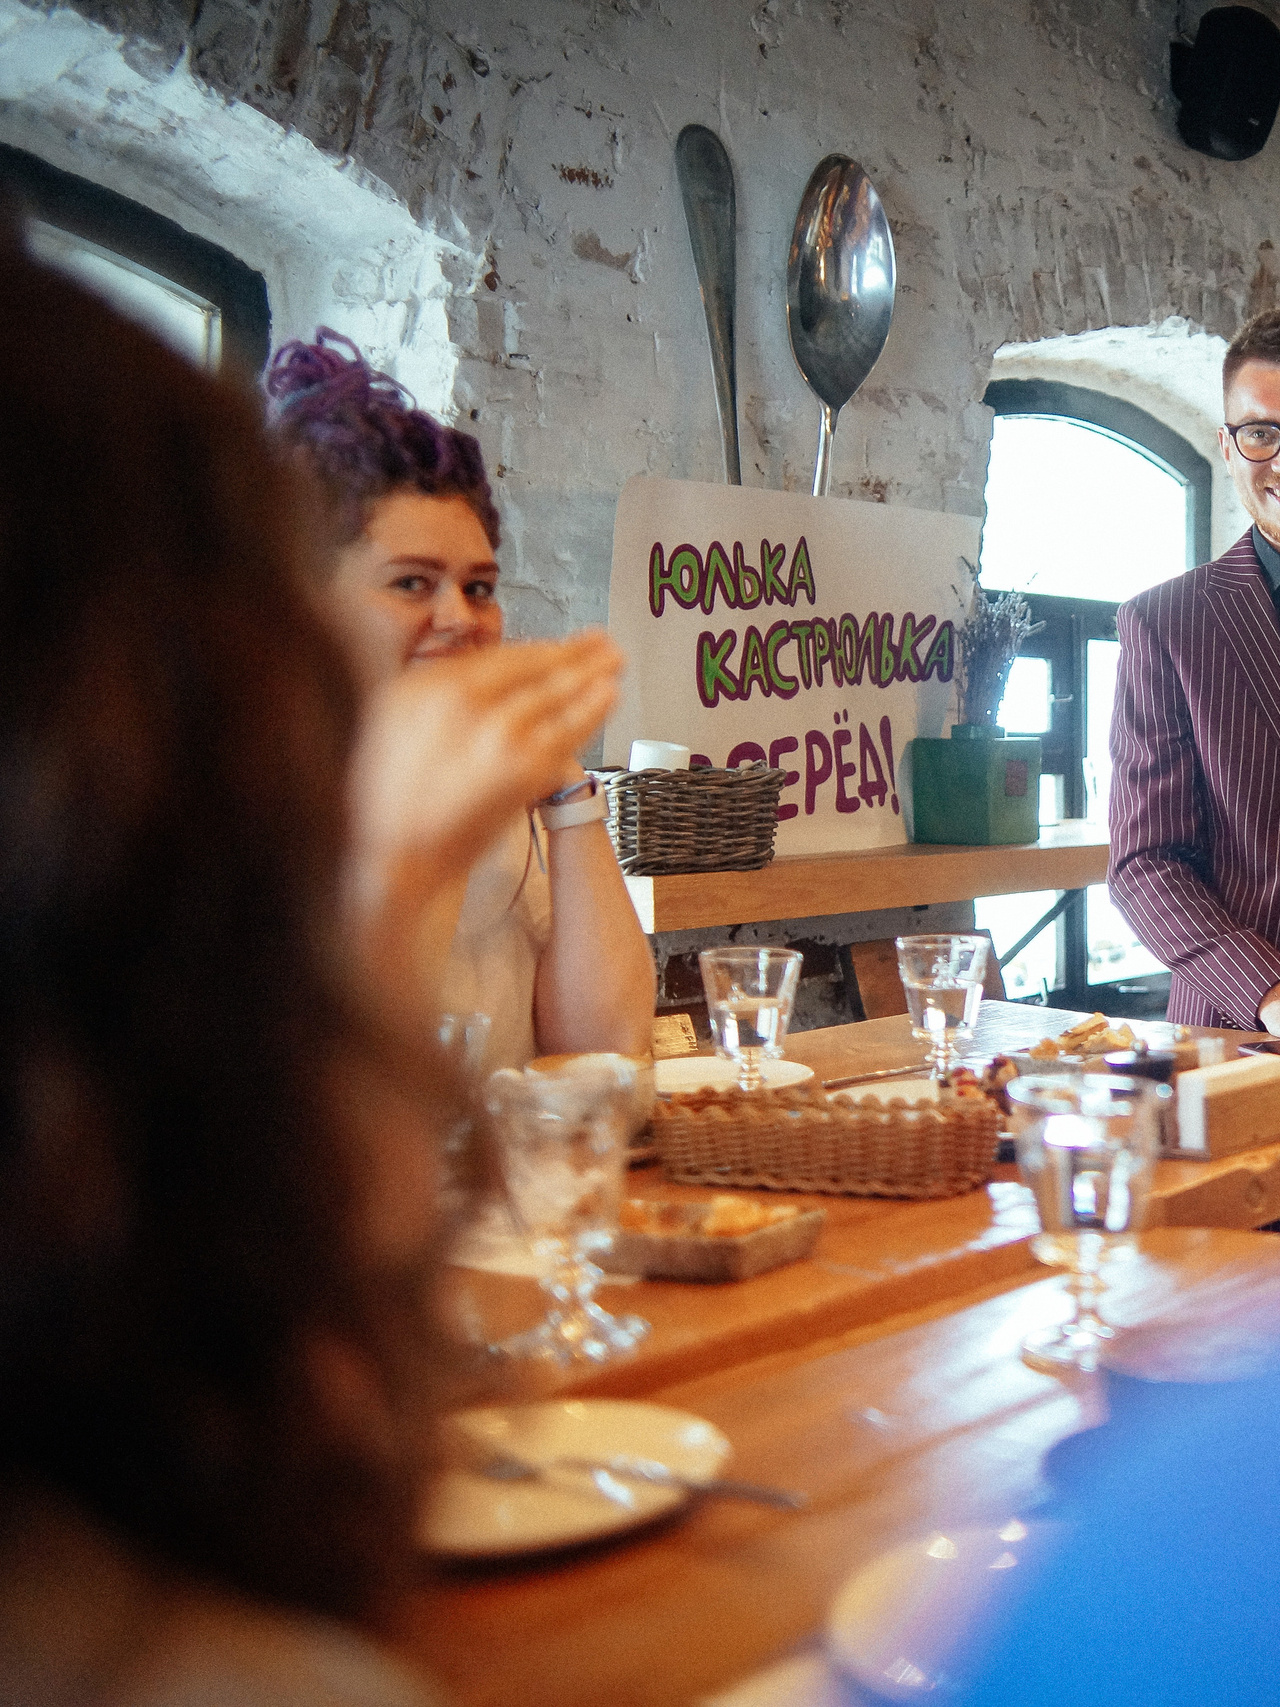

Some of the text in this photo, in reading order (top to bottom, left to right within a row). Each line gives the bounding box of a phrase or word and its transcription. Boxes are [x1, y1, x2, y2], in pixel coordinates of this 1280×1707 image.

[648, 535, 816, 618] ЮЛЬКА
[696, 611, 955, 708] КАСТРЮЛЬКА
[689, 708, 900, 822] ЕРЁД!
